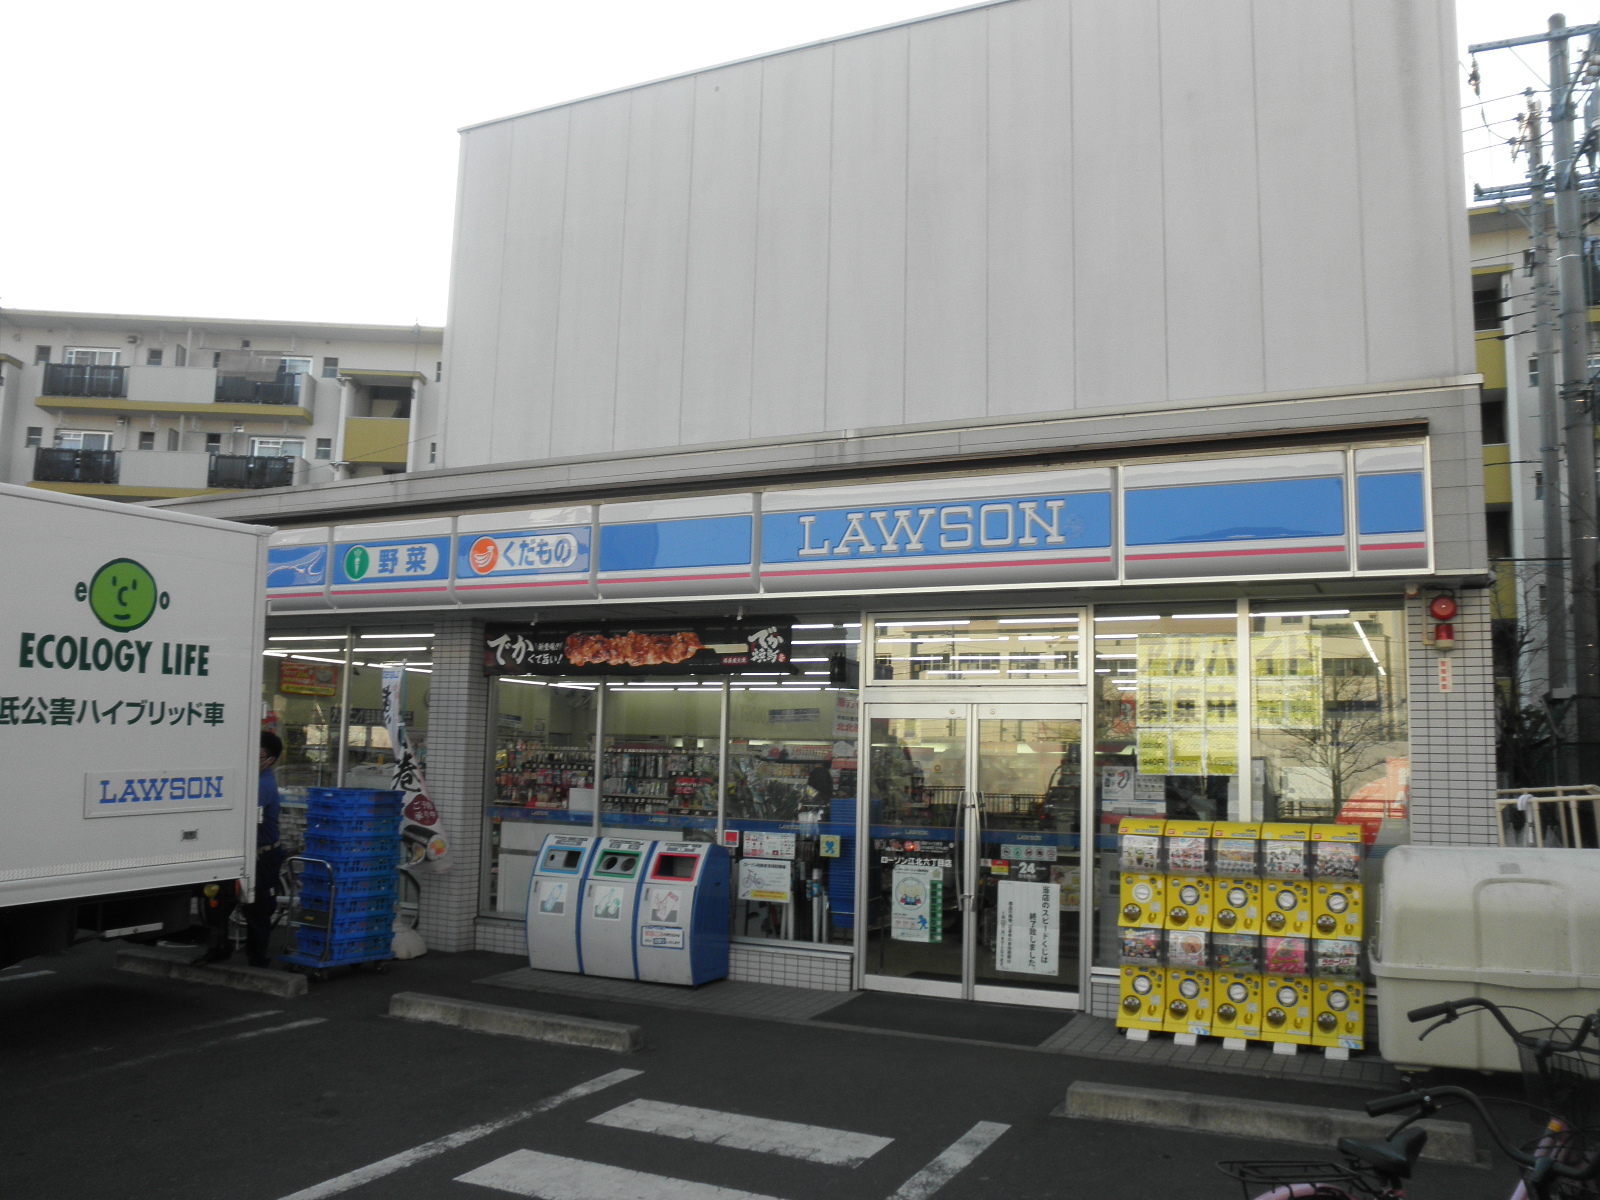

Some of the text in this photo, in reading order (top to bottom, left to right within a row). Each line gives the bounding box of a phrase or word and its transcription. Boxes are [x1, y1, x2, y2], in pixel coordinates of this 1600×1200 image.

[798, 498, 1066, 557] LAWSON
[378, 546, 428, 574] 野菜
[502, 537, 571, 569] くだもの
[19, 632, 210, 677] ECOLOGY LIFE
[99, 775, 224, 804] LAWSON
[880, 856, 953, 868] ローソン江北六丁目店
[1018, 861, 1036, 874] 24
